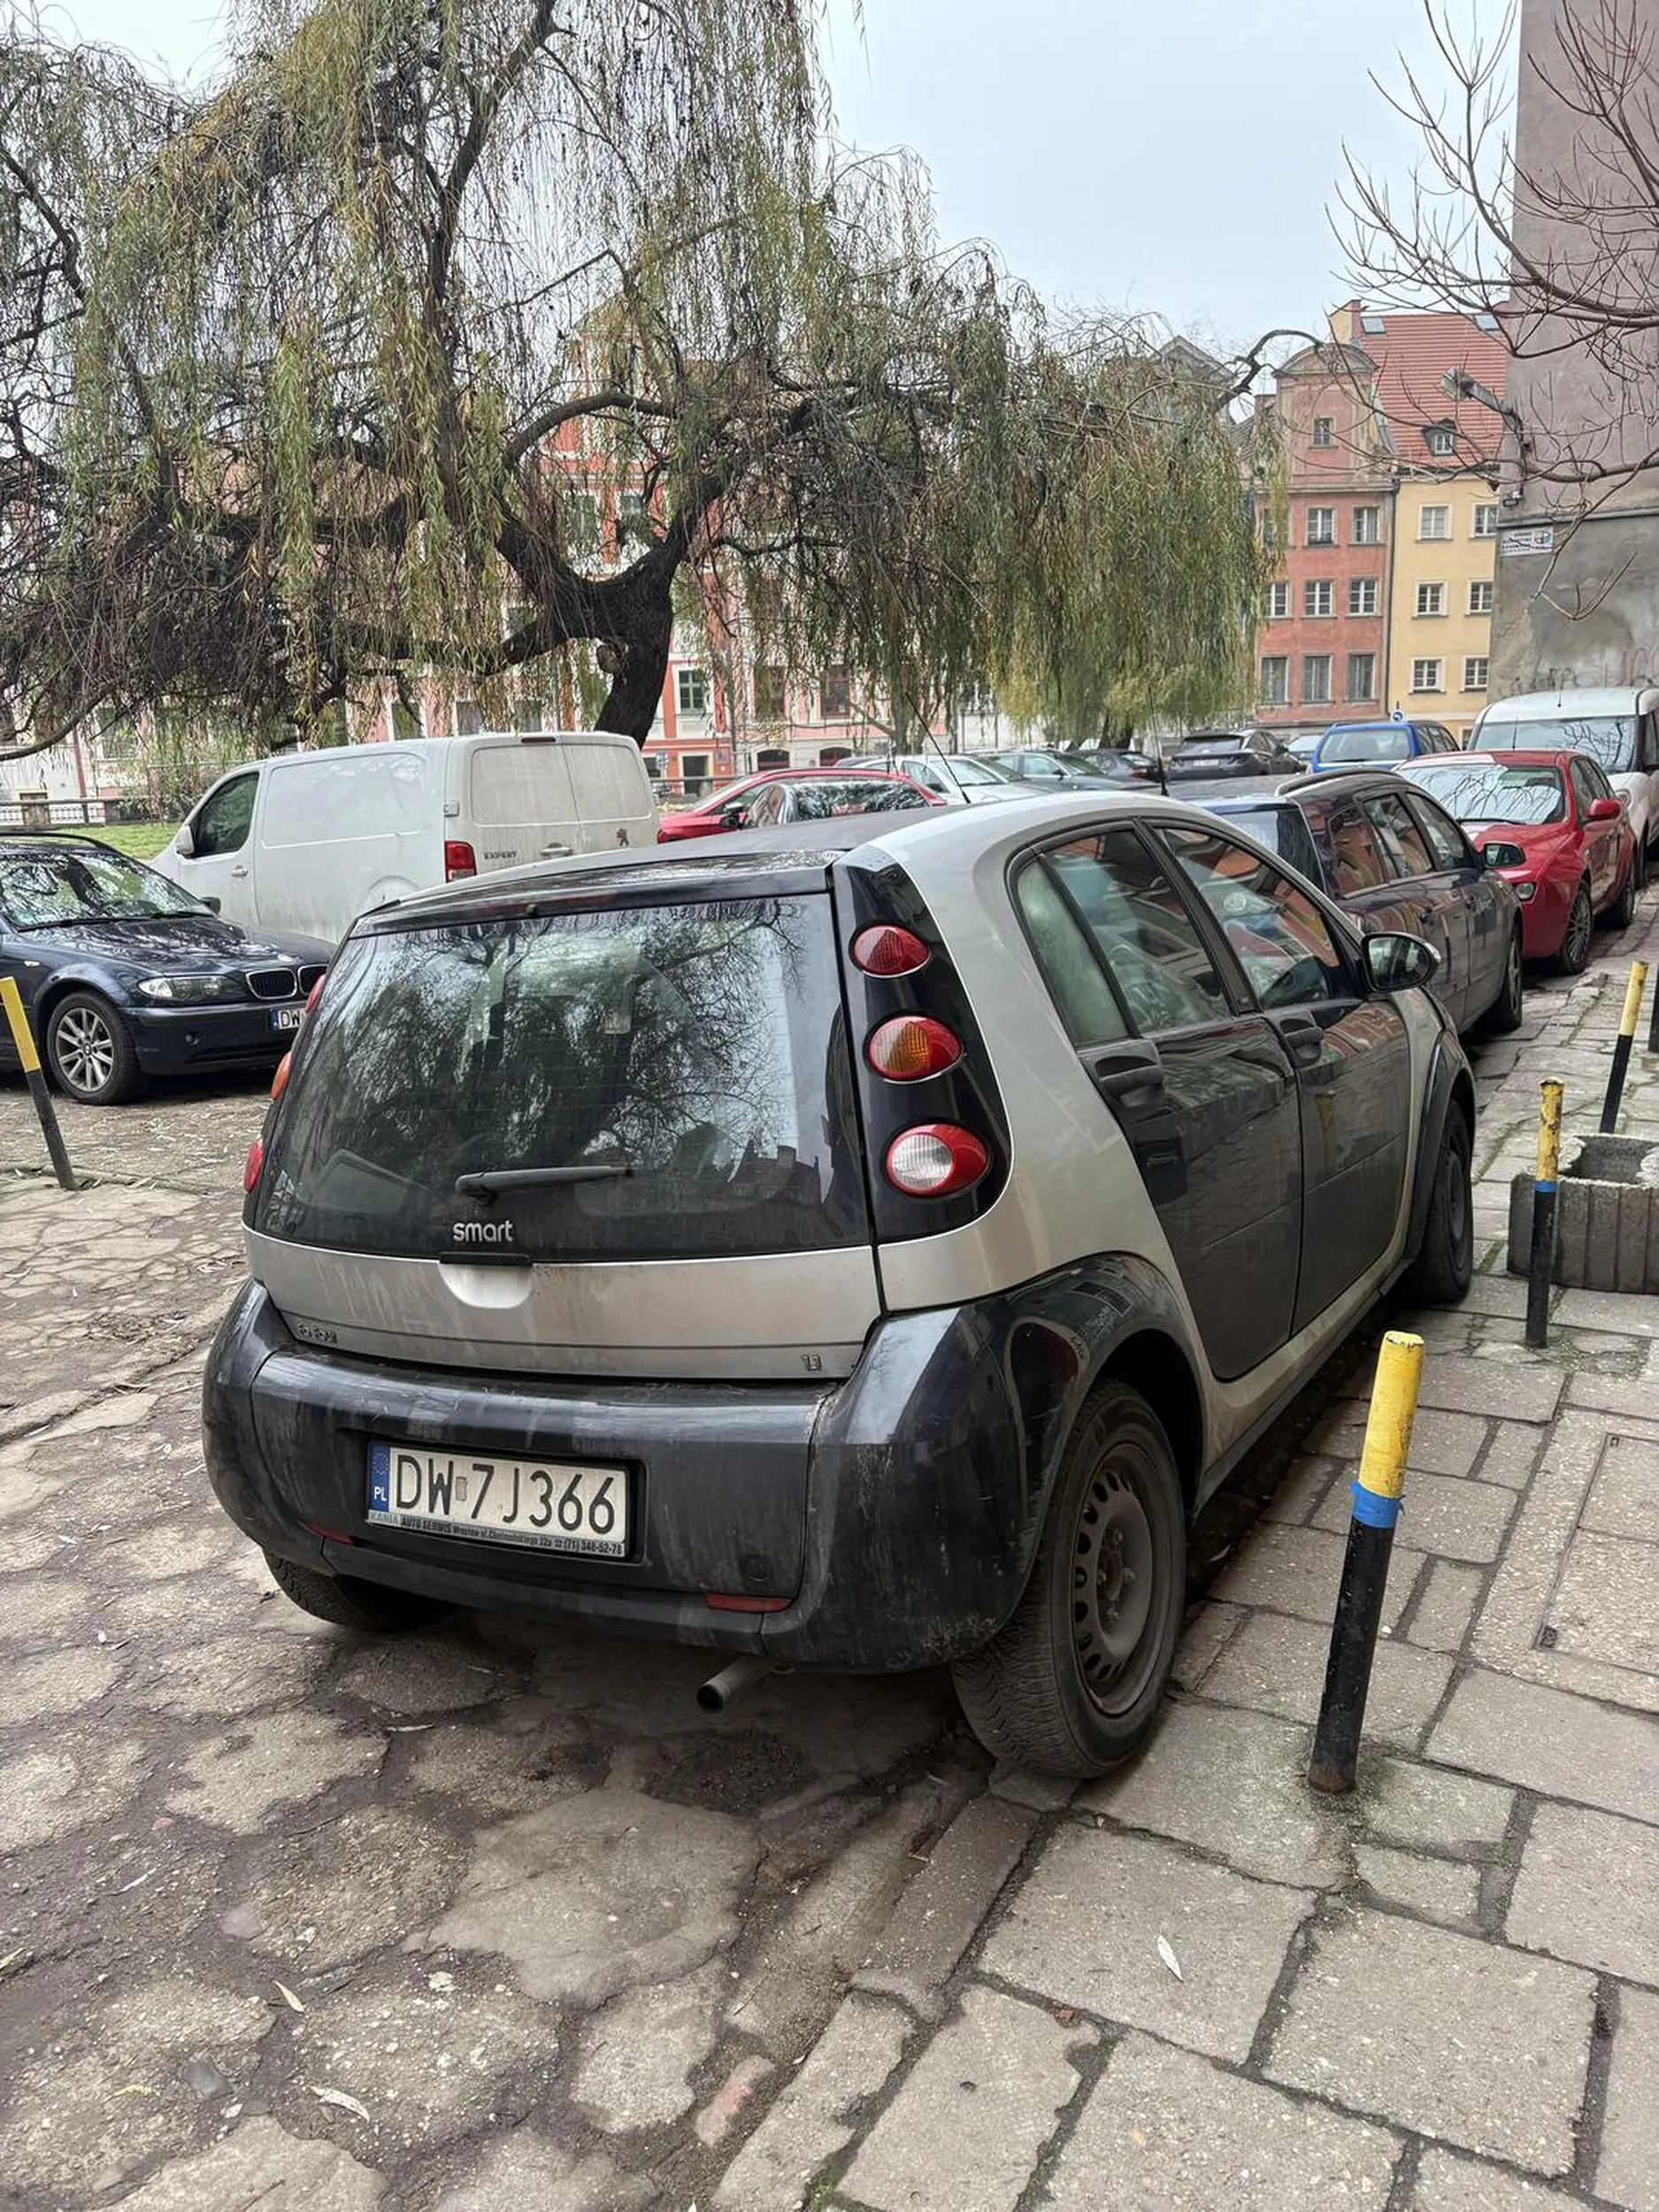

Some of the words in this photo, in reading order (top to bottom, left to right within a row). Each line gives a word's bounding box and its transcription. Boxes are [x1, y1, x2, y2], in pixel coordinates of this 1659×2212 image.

[452, 1220, 513, 1241] smart
[373, 1486, 388, 1502] PL
[396, 1455, 453, 1515] DW
[471, 1464, 615, 1534] 7J366
